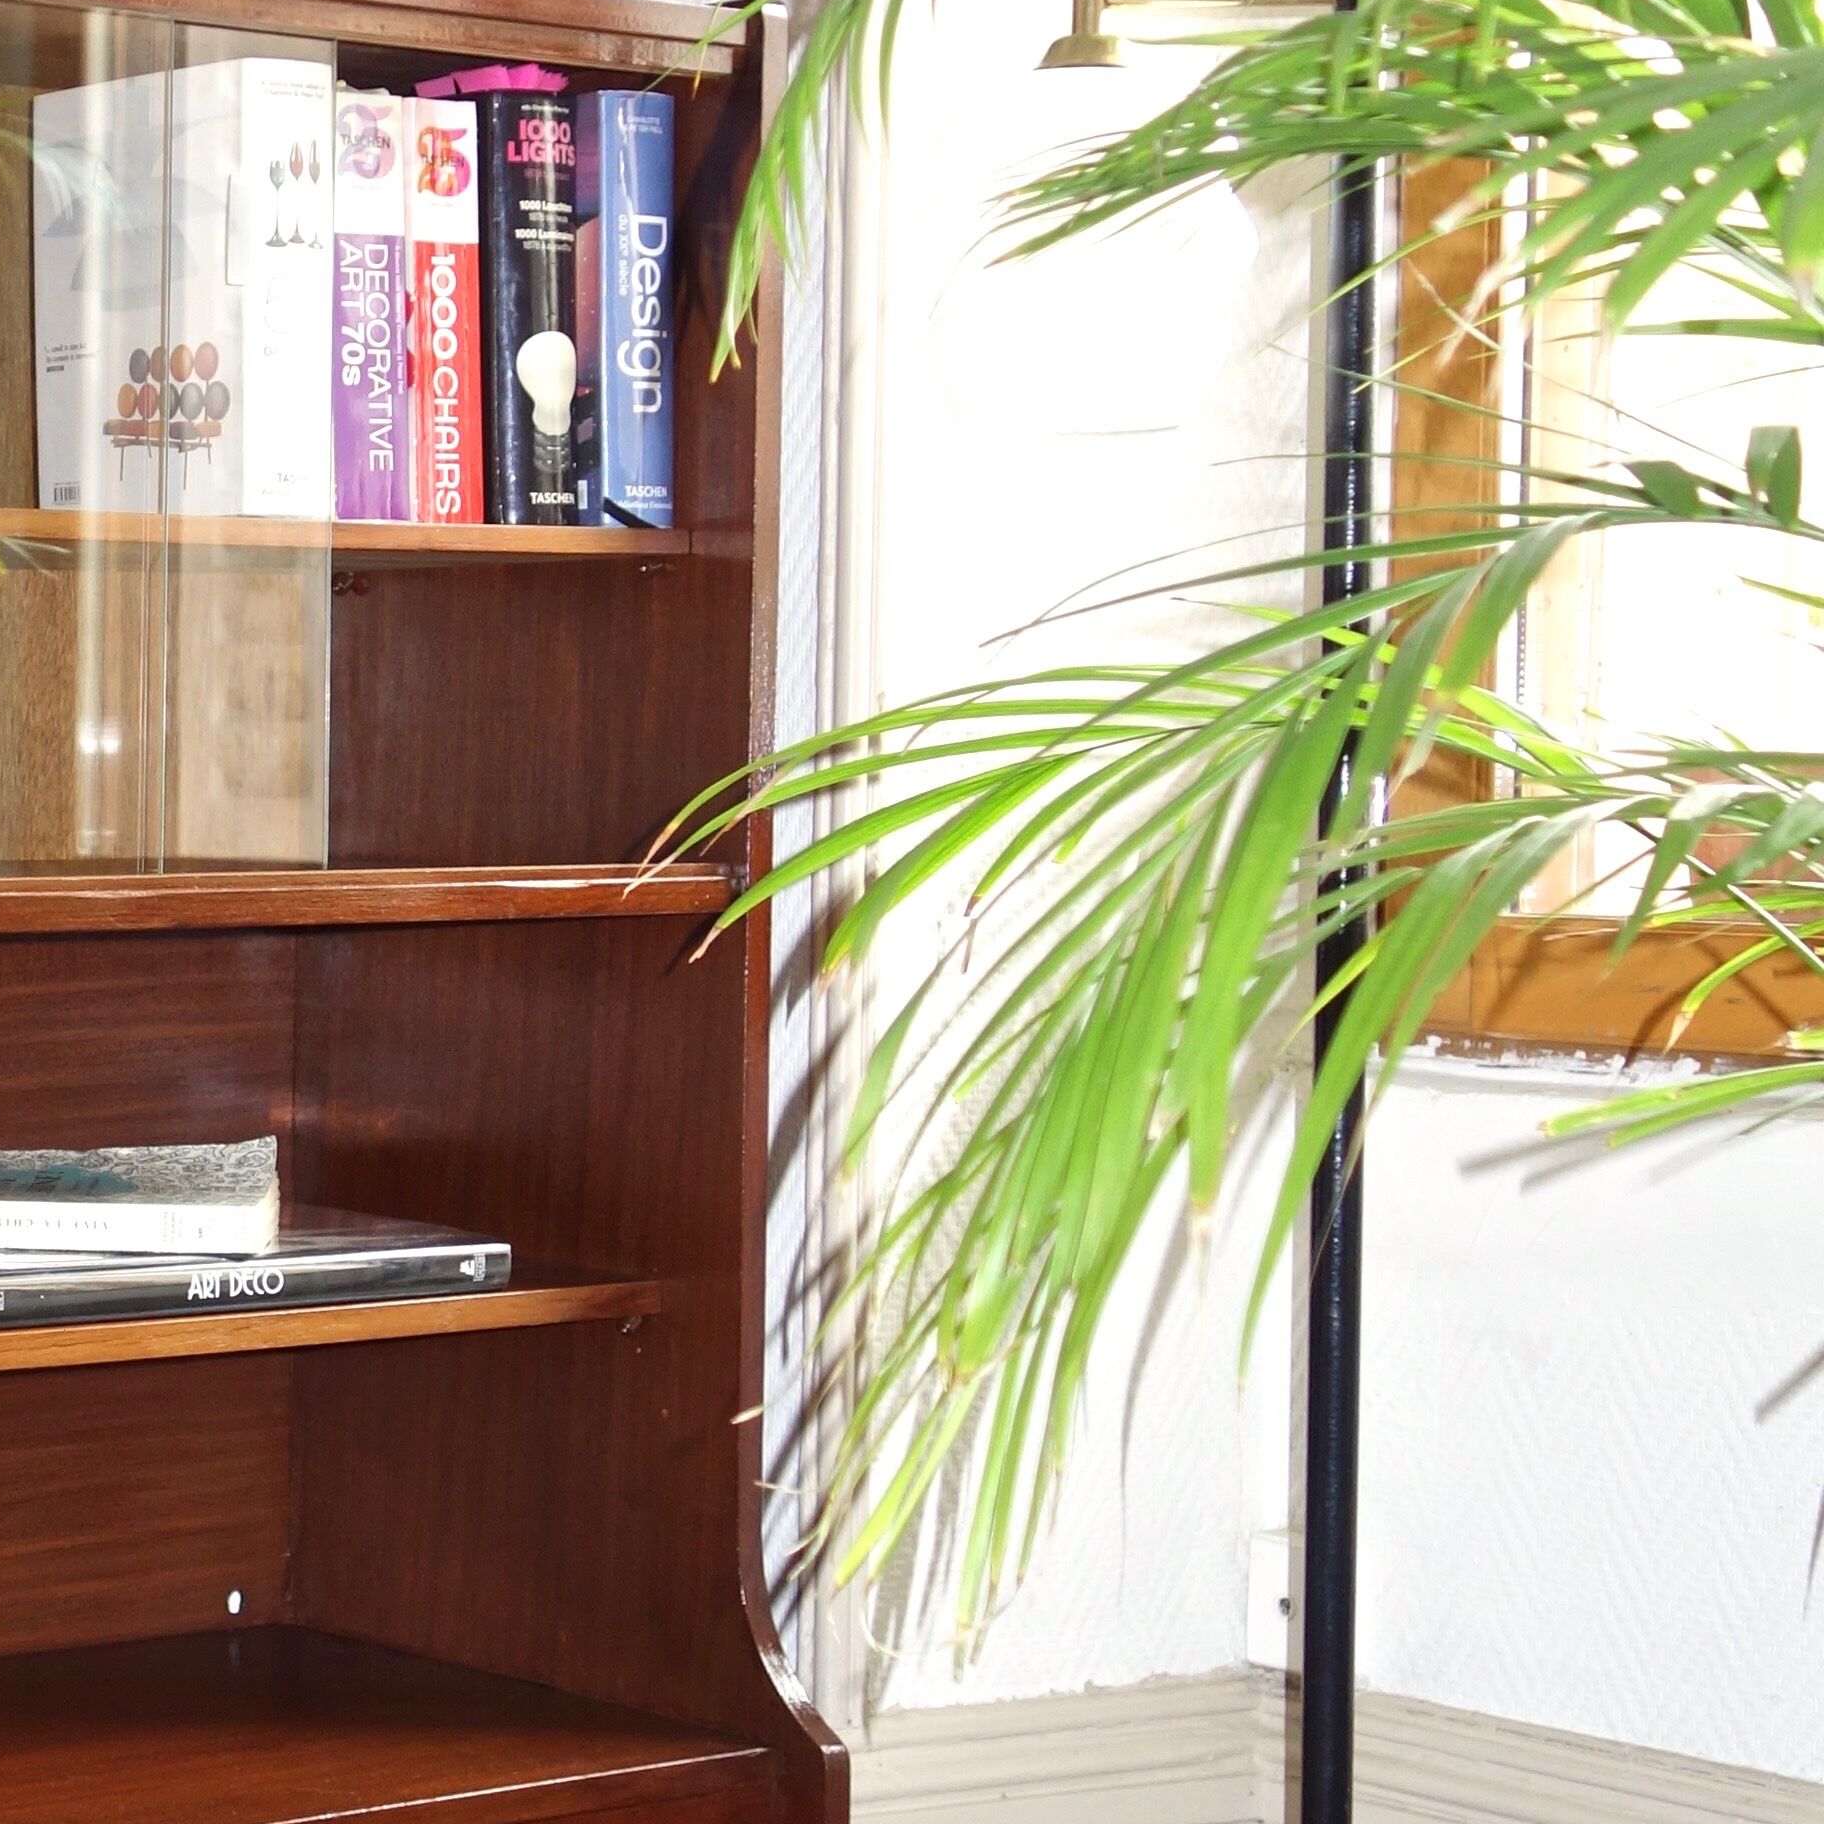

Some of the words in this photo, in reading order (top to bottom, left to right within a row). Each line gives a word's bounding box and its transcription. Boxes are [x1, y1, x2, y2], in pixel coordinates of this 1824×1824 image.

[342, 134, 391, 149] TASCHEN
[507, 140, 576, 167] LIGHTS
[518, 119, 571, 144] 1000
[340, 240, 364, 316] ART
[431, 253, 457, 360] 1000
[617, 214, 668, 413] Design
[341, 325, 366, 387] 70s
[364, 243, 394, 472] DECORATIVE
[433, 366, 461, 515] CHAIRS
[530, 492, 575, 504] TASCHEN
[625, 485, 667, 498] TASCHEN
[187, 1271, 223, 1300] ART
[229, 1267, 285, 1297] DECO
